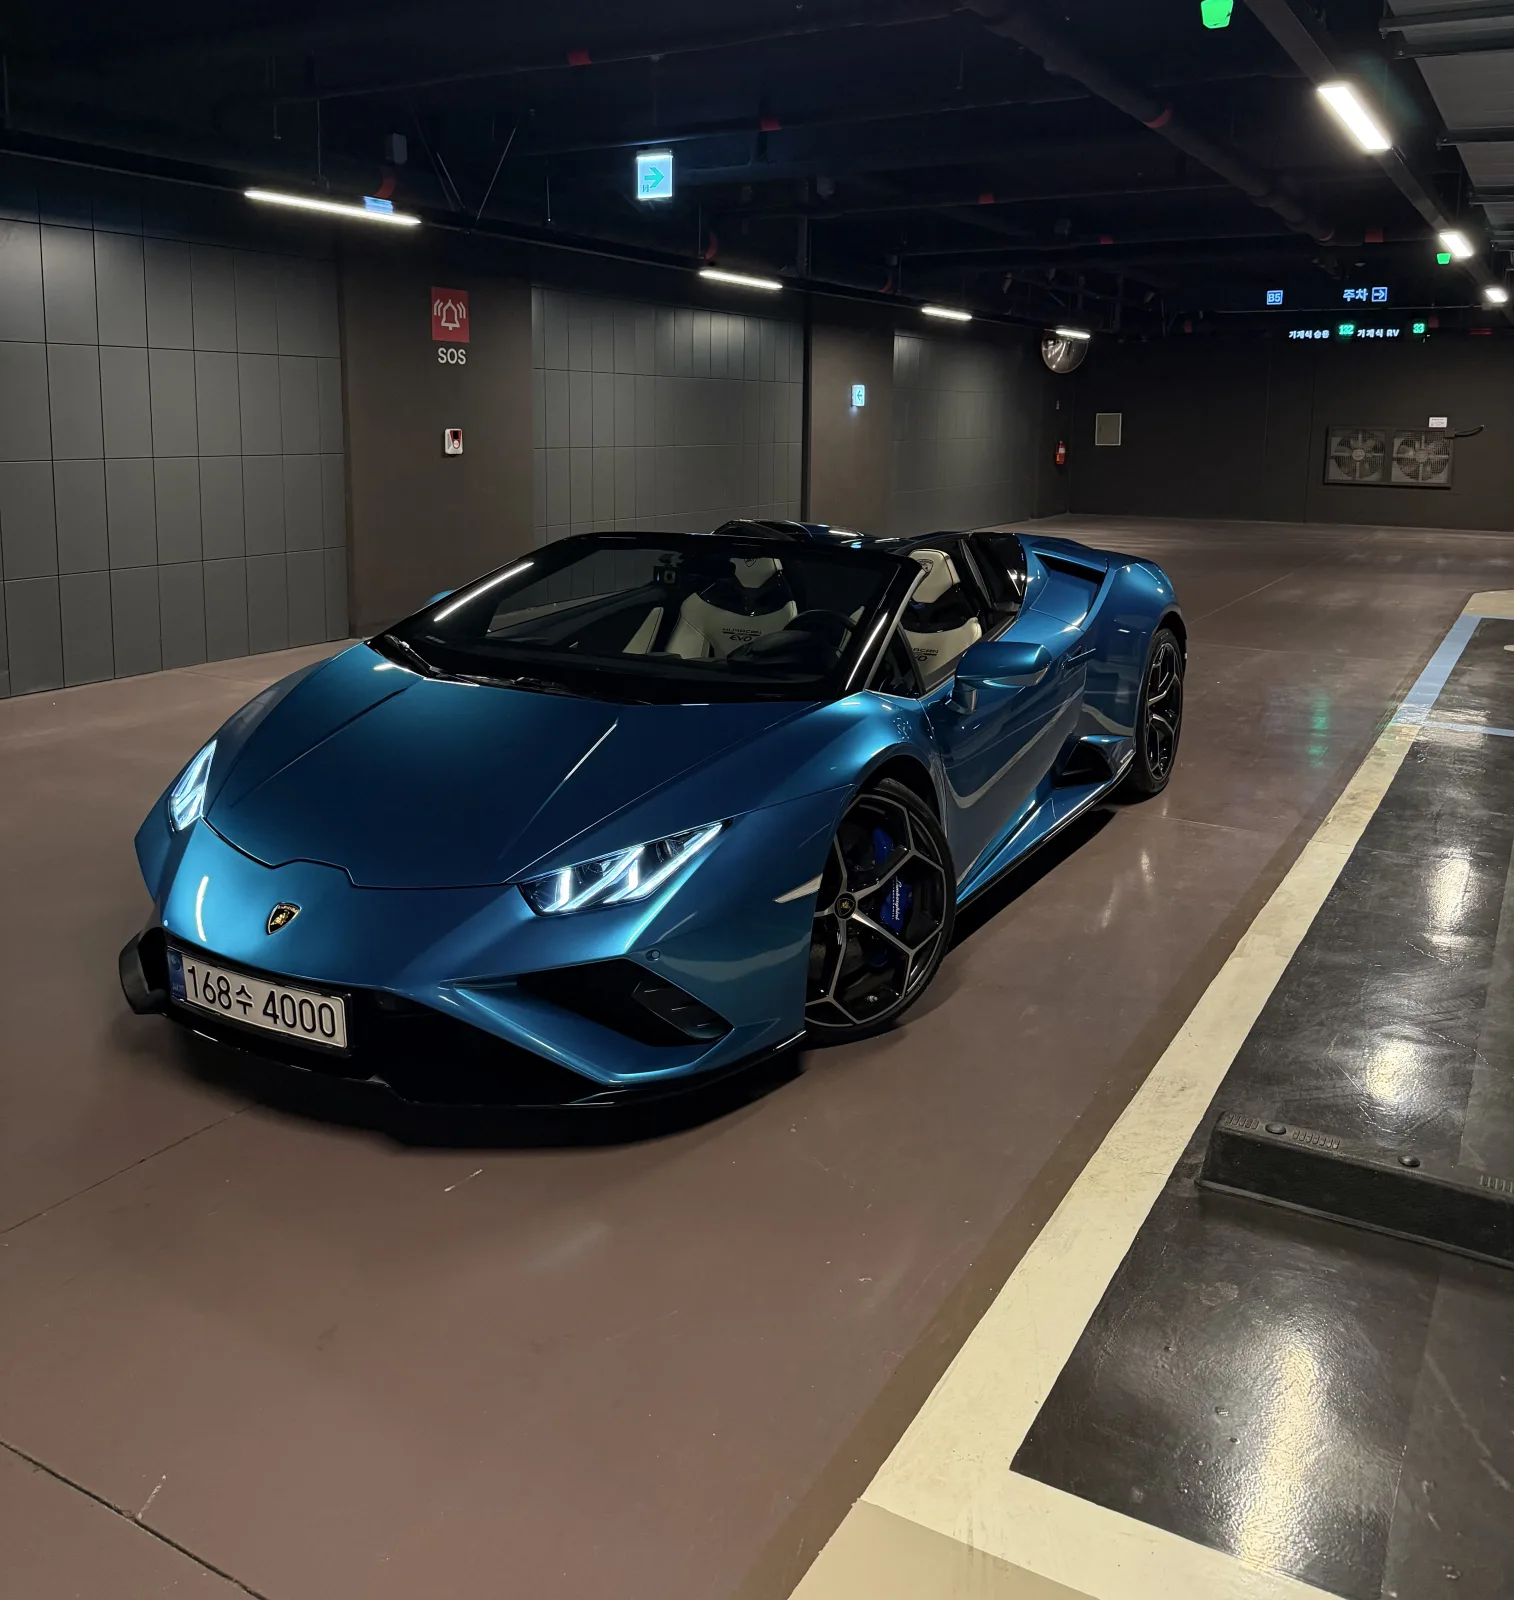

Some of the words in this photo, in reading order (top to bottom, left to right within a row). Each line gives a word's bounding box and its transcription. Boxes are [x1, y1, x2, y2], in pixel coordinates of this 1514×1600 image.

[1268, 293, 1281, 303] B5
[1342, 288, 1369, 302] 주차
[1338, 324, 1355, 335] 132
[1357, 328, 1384, 338] 기계식
[1386, 329, 1400, 337] RV
[1288, 330, 1313, 340] 기계식
[1313, 330, 1330, 339] 승용
[437, 347, 467, 365] SOS
[729, 634, 753, 642] EVO
[187, 964, 254, 1015] 168수
[262, 988, 336, 1038] 4000
